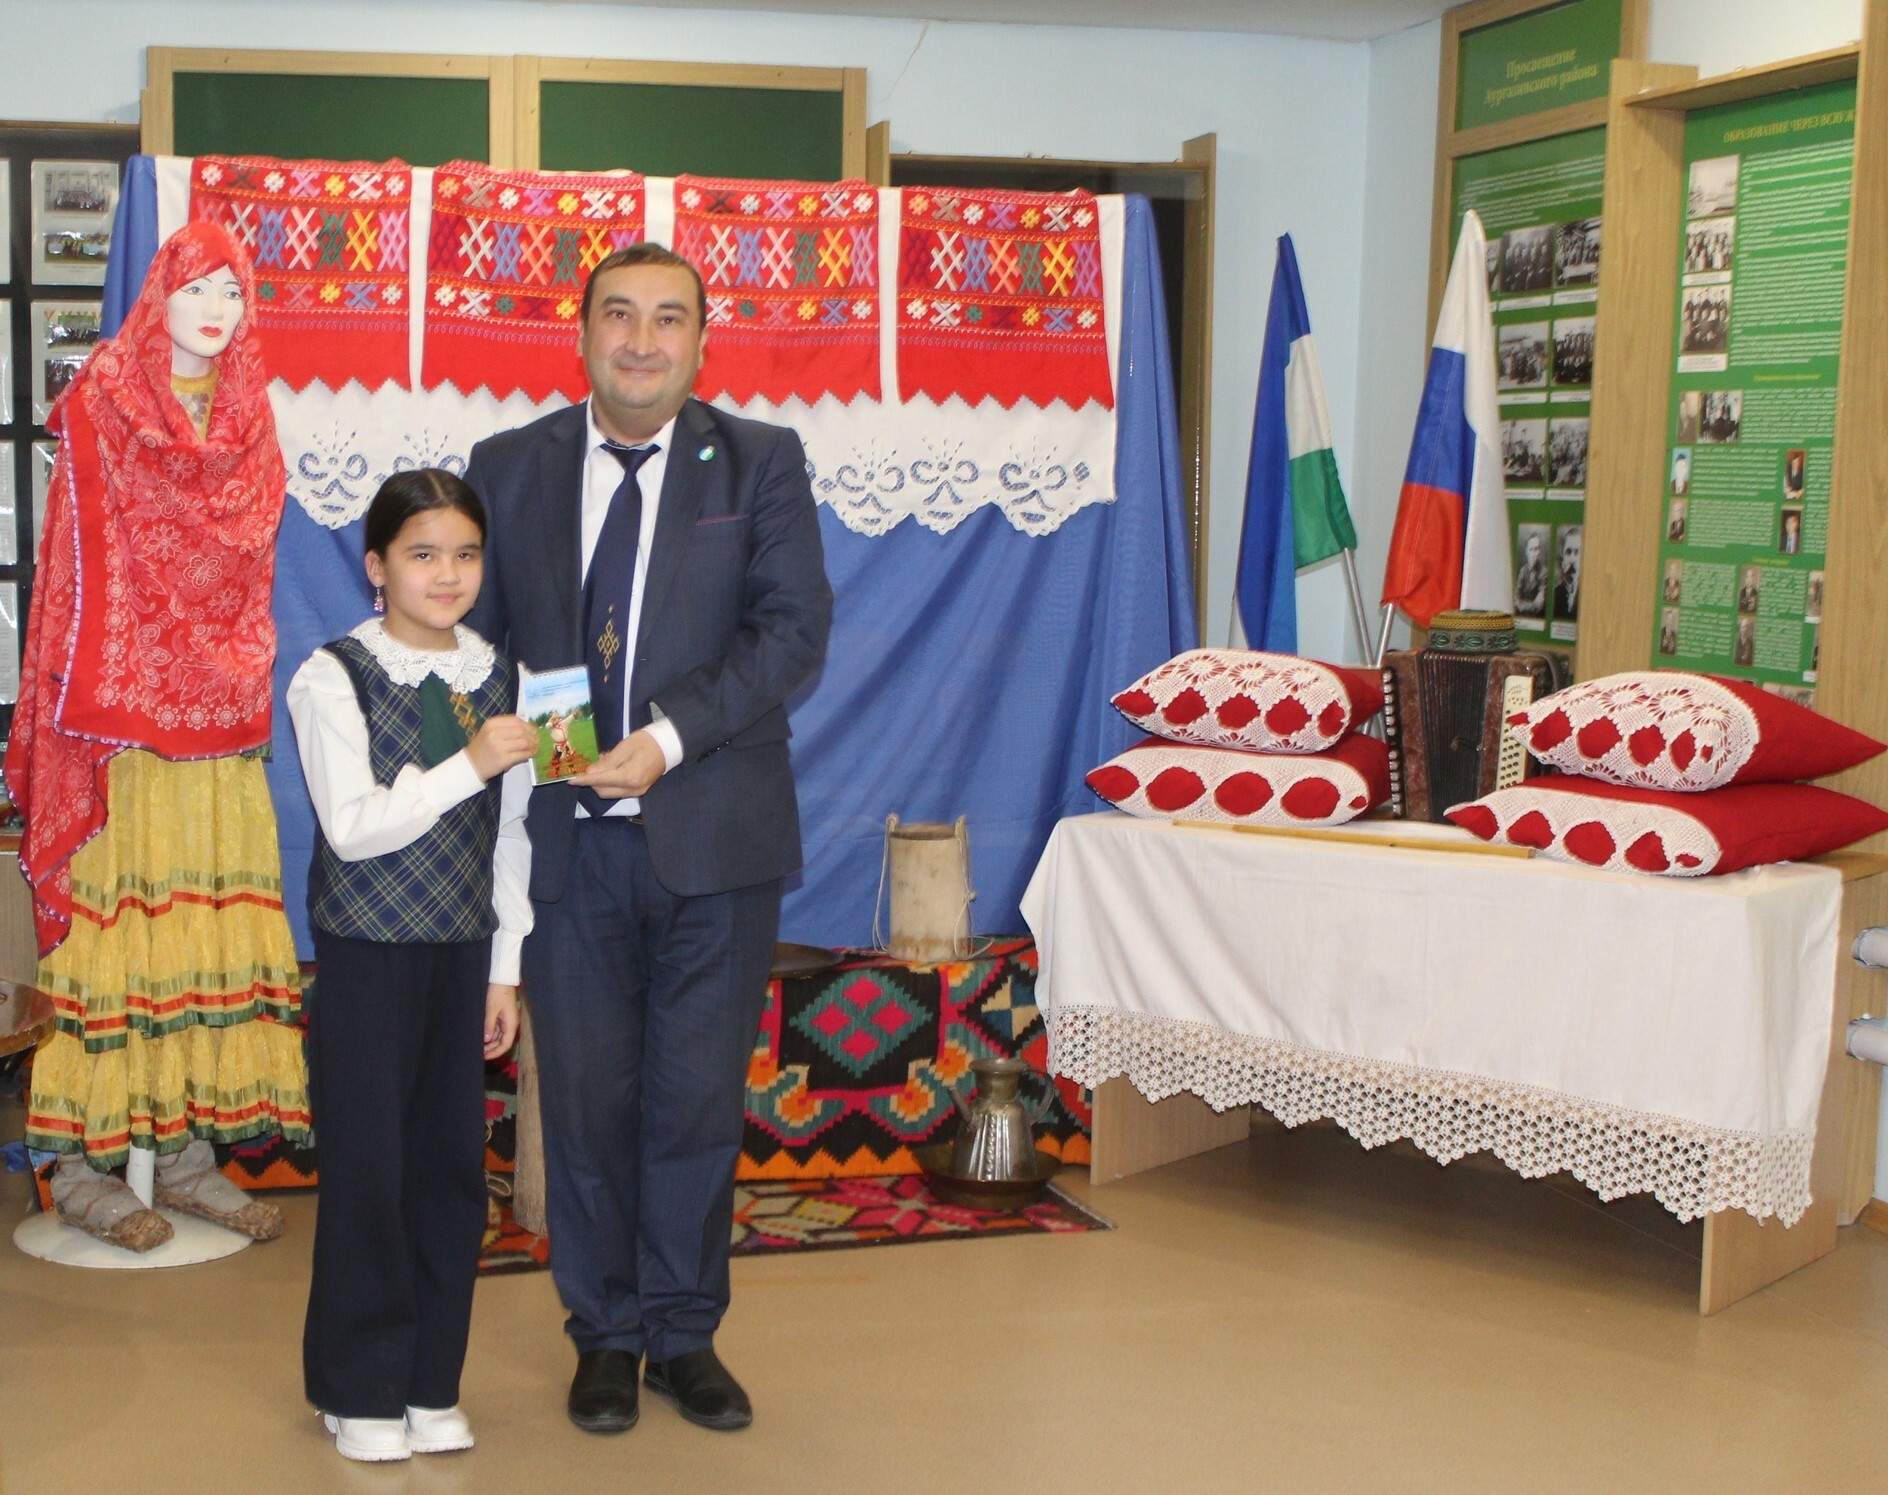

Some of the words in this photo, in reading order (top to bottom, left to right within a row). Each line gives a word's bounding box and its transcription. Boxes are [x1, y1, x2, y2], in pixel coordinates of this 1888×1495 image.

[1506, 49, 1577, 81] Просвещение
[1559, 63, 1598, 91] района
[1723, 120, 1789, 143] ОБРАЗОВАНИЕ
[1790, 115, 1819, 132] ЧЕРЕЗ
[1819, 111, 1845, 126] ВСЮ
